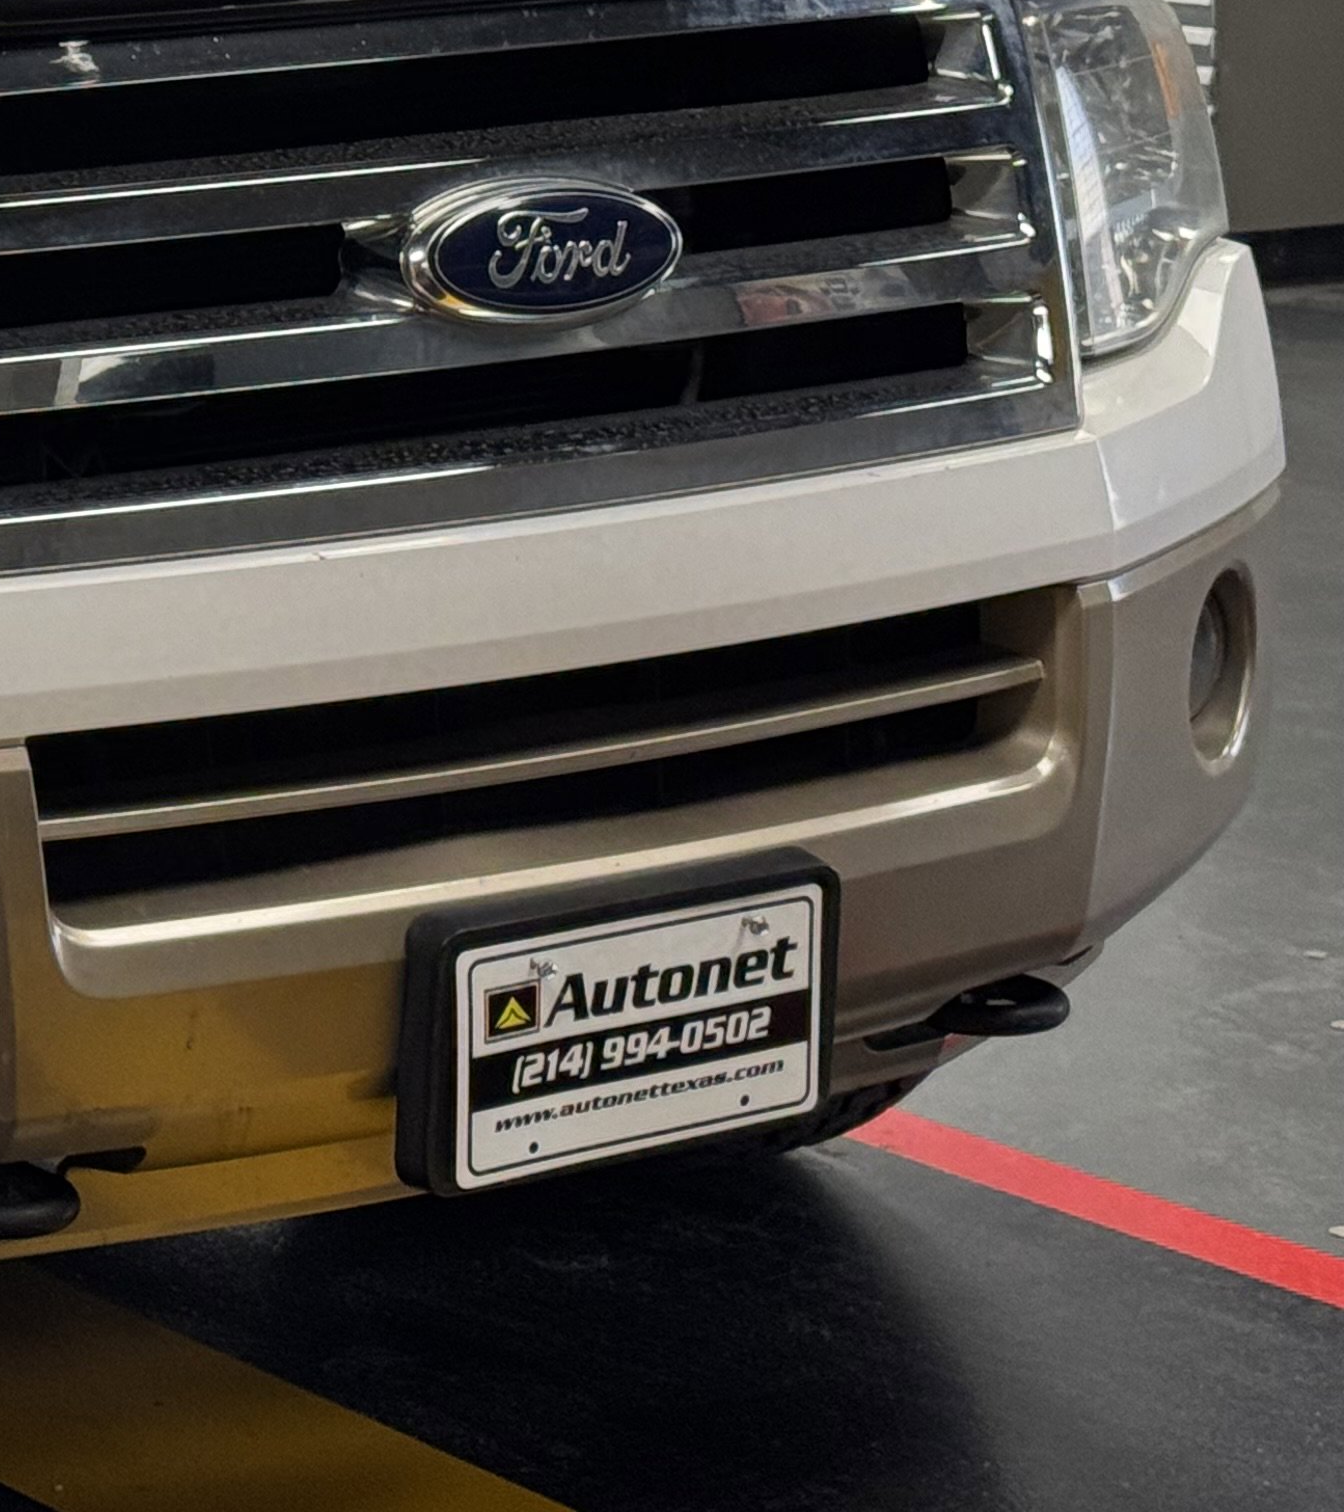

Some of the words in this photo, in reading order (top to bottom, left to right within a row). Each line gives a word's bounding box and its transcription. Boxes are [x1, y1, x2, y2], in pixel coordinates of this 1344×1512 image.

[488, 207, 631, 288] Ford
[543, 936, 797, 1028] Autonet
[512, 1045, 593, 1094] (214)
[600, 1005, 772, 1071] 994-0502
[494, 1059, 785, 1134] www.autonettexas.com
